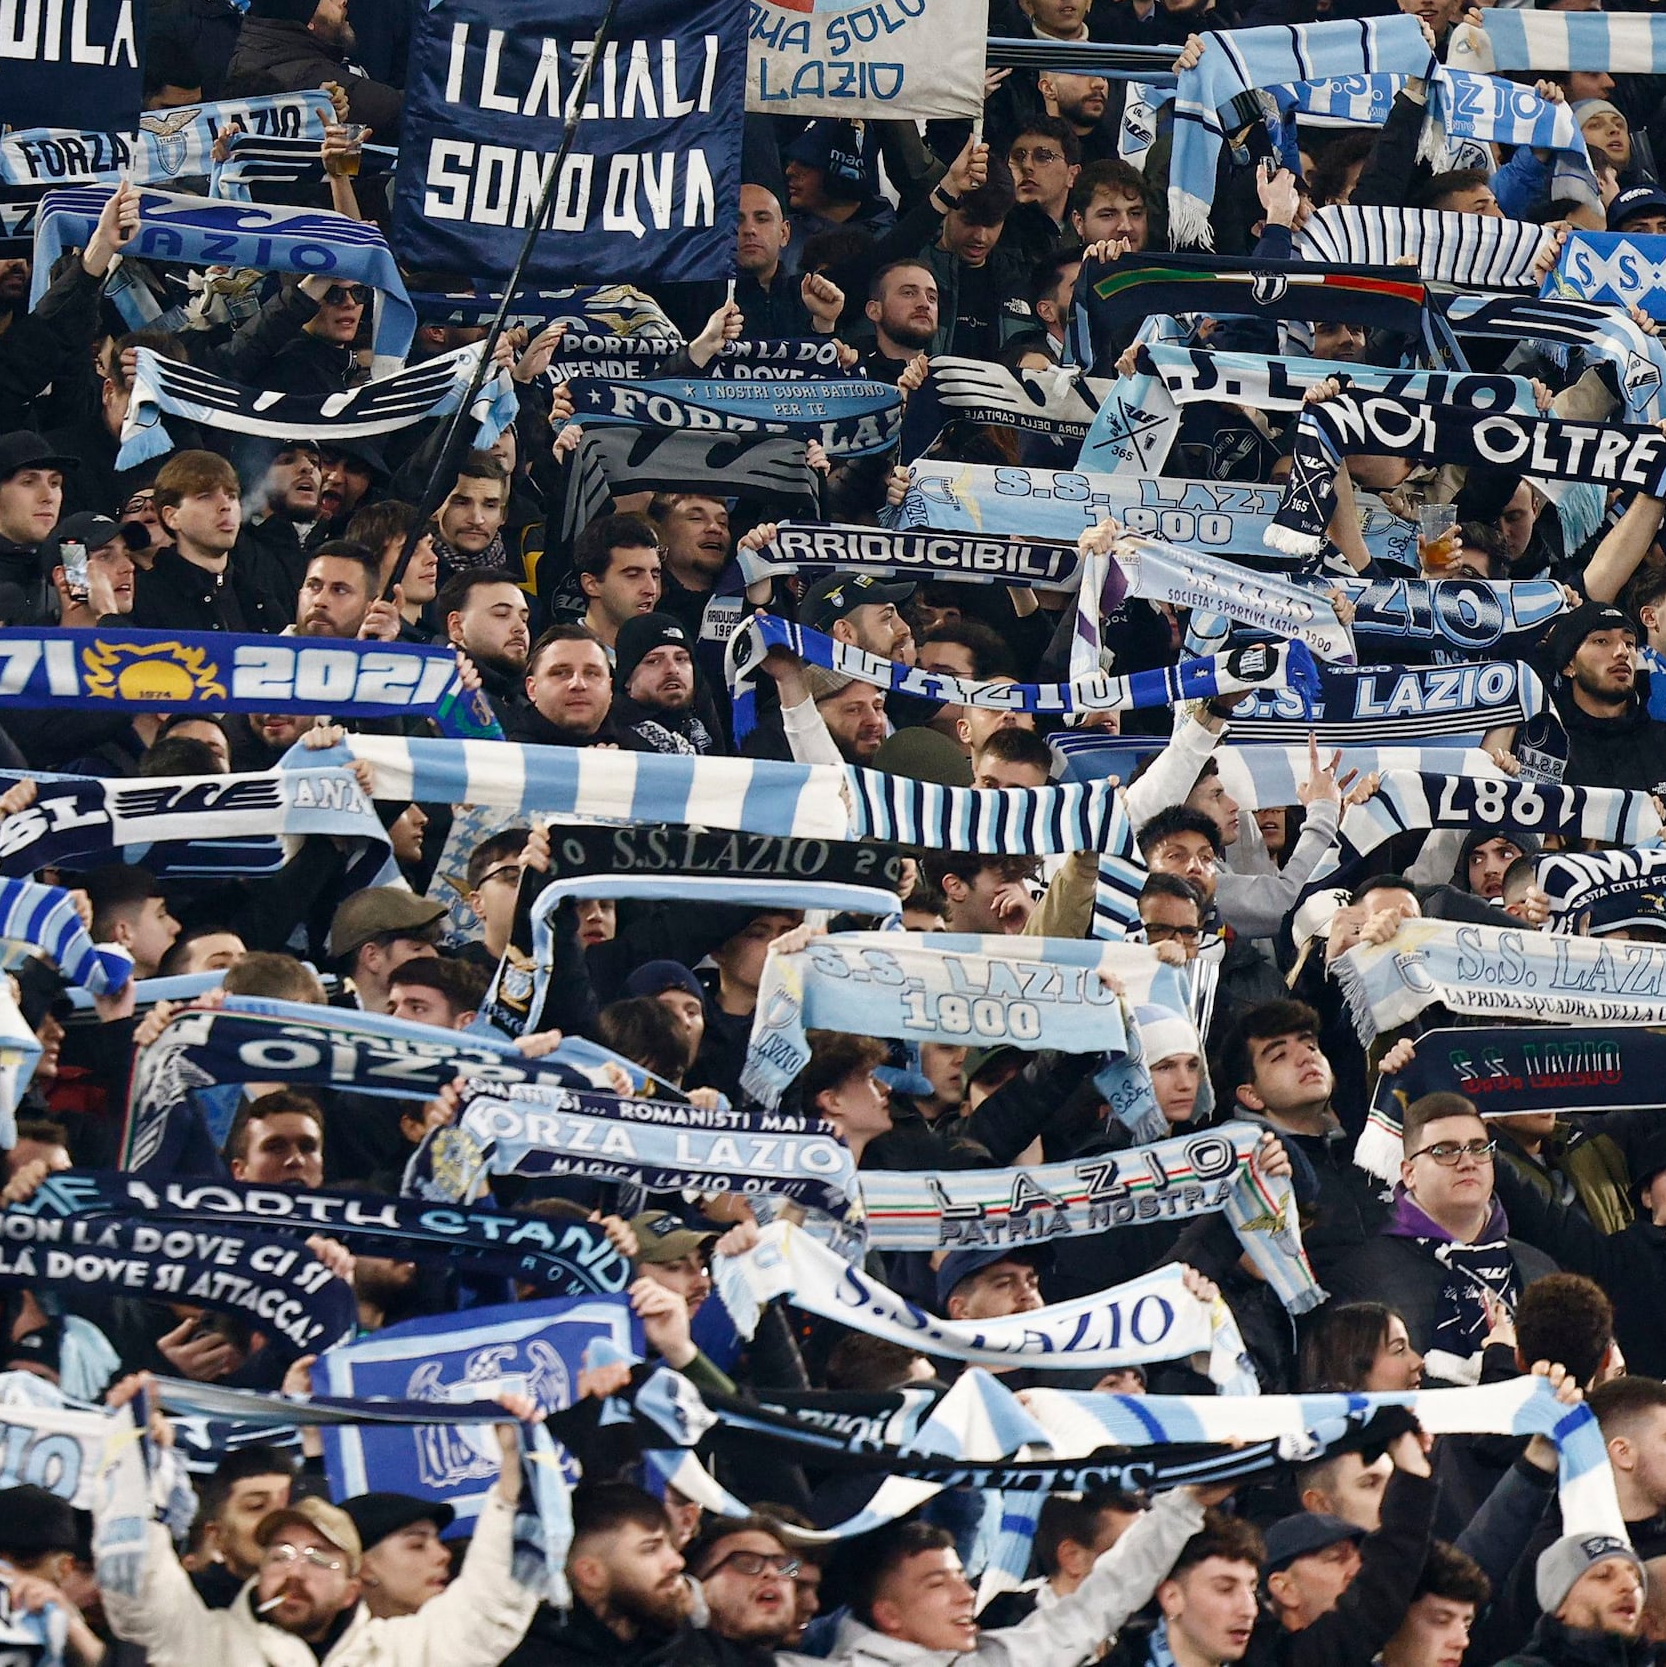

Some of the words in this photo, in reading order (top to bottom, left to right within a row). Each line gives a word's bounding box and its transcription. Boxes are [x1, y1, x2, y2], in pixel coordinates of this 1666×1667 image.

[444, 22, 469, 105] I
[484, 28, 720, 122] LAZIALI
[761, 57, 905, 100] LAZIO
[24, 129, 131, 180] FORZA
[208, 104, 303, 141] LAZIO
[712, 385, 769, 399] NOSTRI
[773, 384, 817, 398] CUORI
[820, 383, 884, 398] BATTONO
[773, 402, 808, 416] PER
[1330, 387, 1439, 457] NOI
[1472, 412, 1662, 487] OLTRE
[994, 465, 1112, 504] S.S.
[769, 530, 1064, 582] IRRIDUCIBILI
[1167, 587, 1214, 608] SOCIETA'
[1216, 599, 1266, 624] SPORTIVA
[1269, 616, 1301, 637] LAZIO
[1303, 628, 1333, 653] 1900
[233, 646, 459, 707] 2021
[1352, 660, 1521, 720] LAZIO
[611, 832, 683, 873] S.S.
[684, 835, 832, 877] LAZIO
[1457, 927, 1537, 985] S.S.
[902, 990, 1042, 1043] 1900
[619, 1104, 753, 1133] ROMANISTI
[549, 1155, 643, 1187] MAGICA
[654, 1171, 732, 1193] LAZIO
[675, 1131, 845, 1172] LAZIO
[926, 1136, 1236, 1219] LAZIO
[939, 1211, 1074, 1248] PATRIA
[1086, 1182, 1235, 1231] NOSTRA
[132, 1224, 244, 1267] DOVE
[250, 1245, 291, 1275] CI
[293, 1260, 334, 1294] SI
[418, 1210, 632, 1294] STAND
[45, 1250, 150, 1287] DOVE
[152, 1259, 189, 1288] SI
[193, 1267, 329, 1350] ATTACCA!
[971, 1293, 1176, 1355] LAZIO
